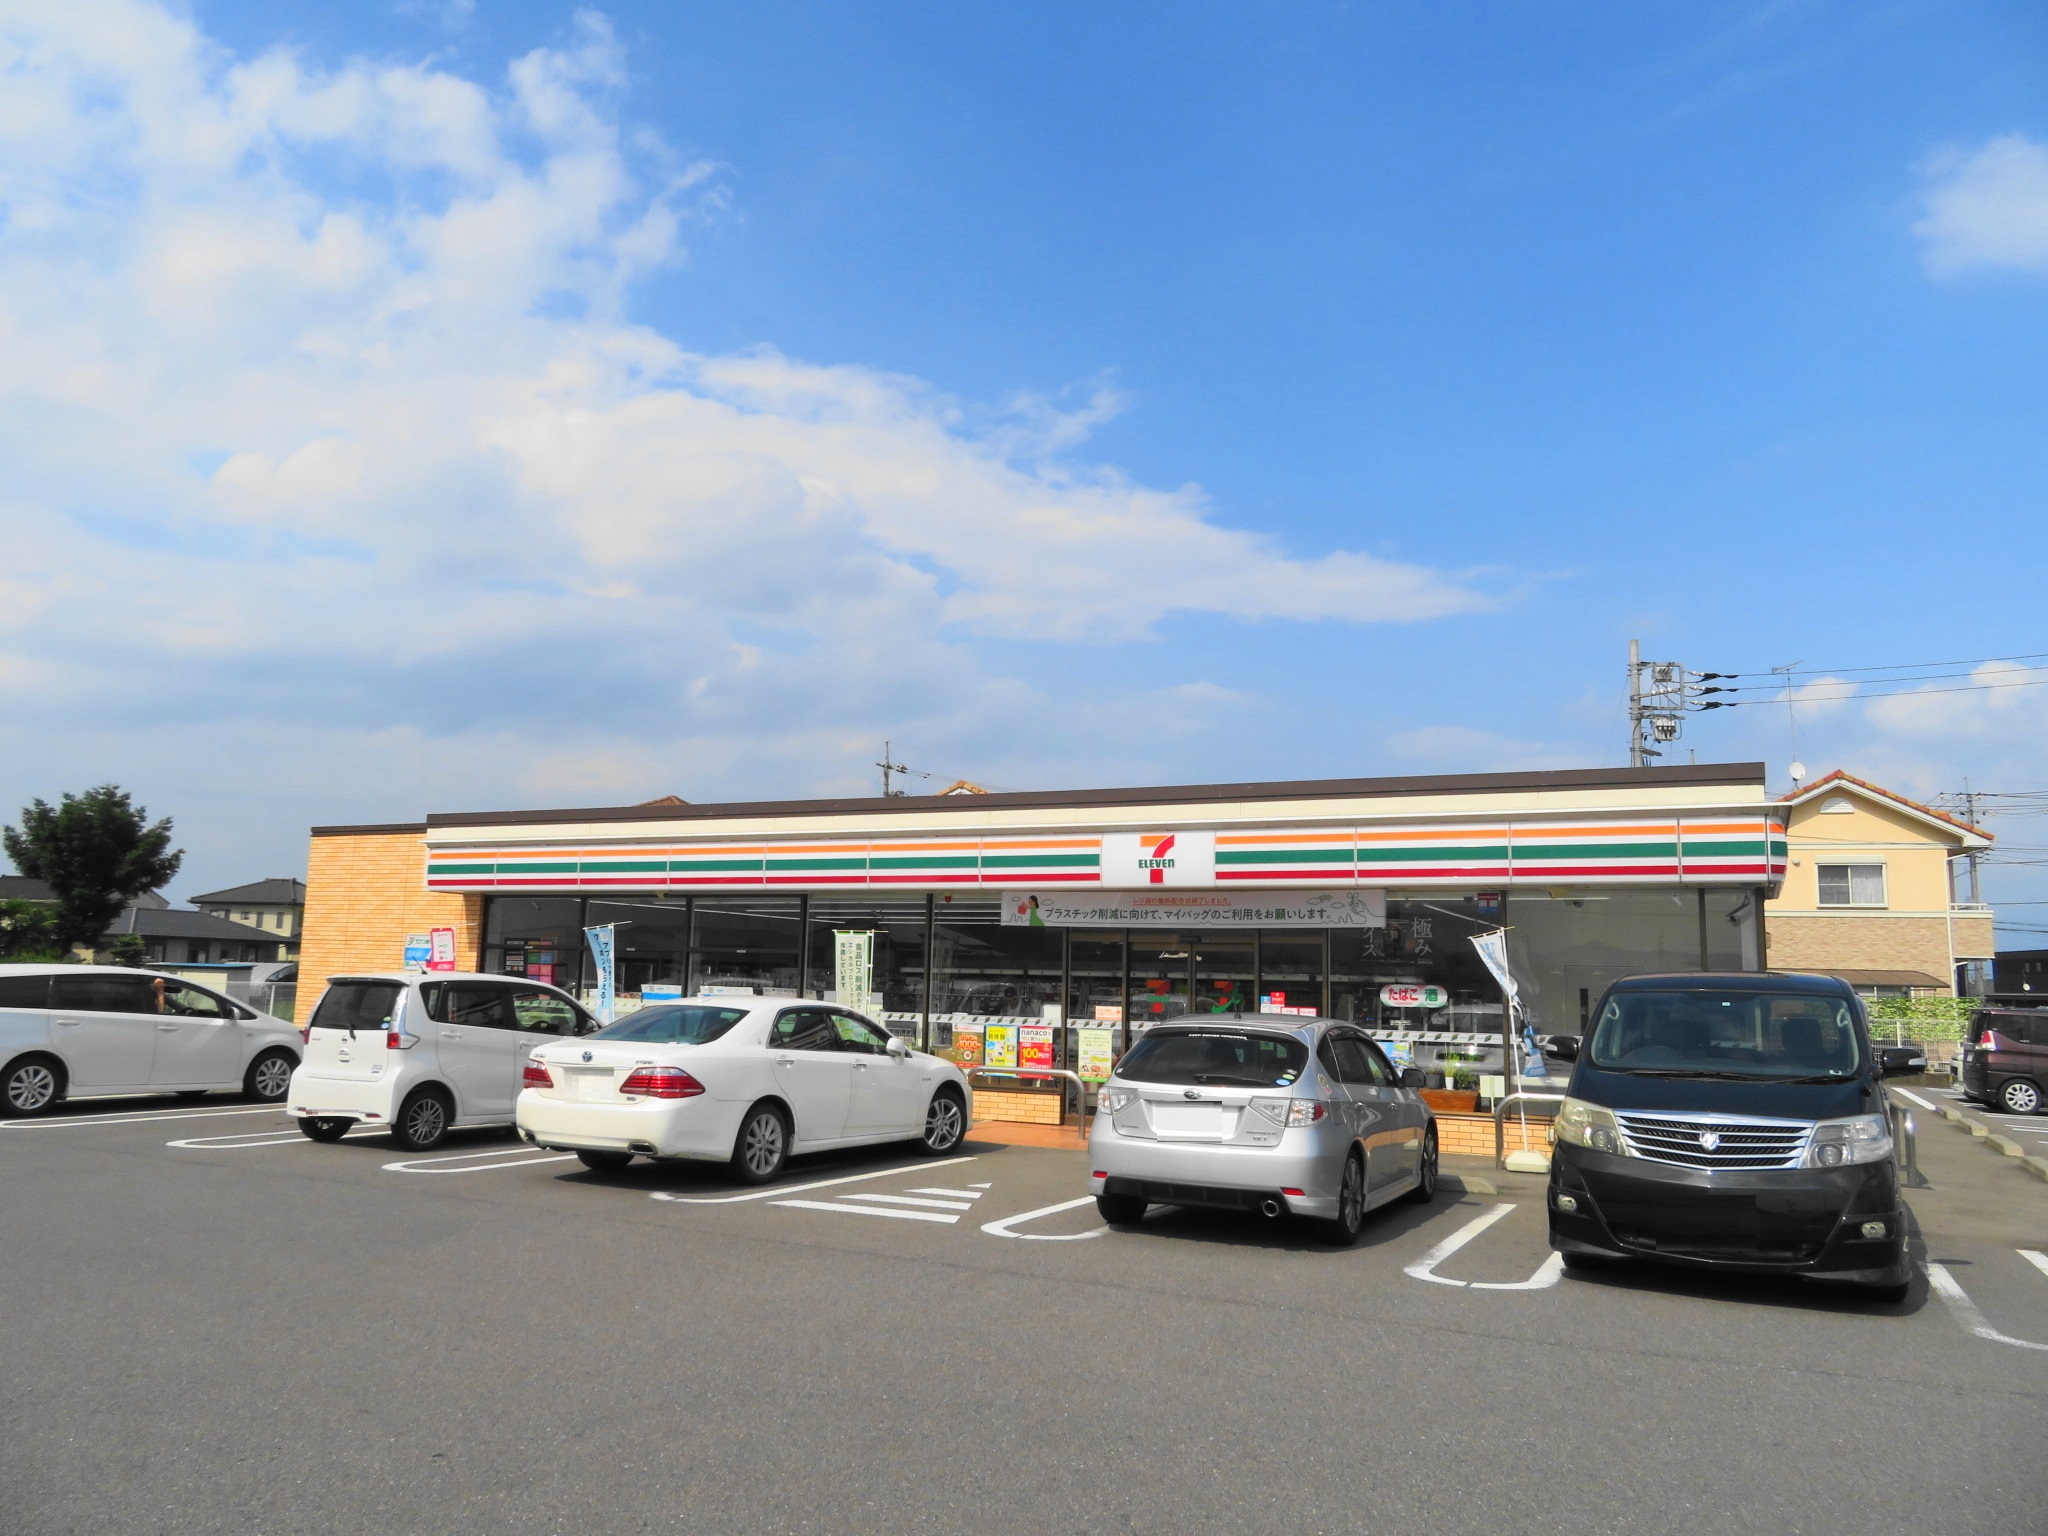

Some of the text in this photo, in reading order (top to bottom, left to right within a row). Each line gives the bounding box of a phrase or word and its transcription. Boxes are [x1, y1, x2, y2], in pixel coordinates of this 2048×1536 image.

[1140, 834, 1175, 884] 7
[1044, 907, 1332, 921] プラスチック削減に向けて、マイバッグのご利用をお願いします。
[1388, 987, 1438, 1002] たばこ 酒
